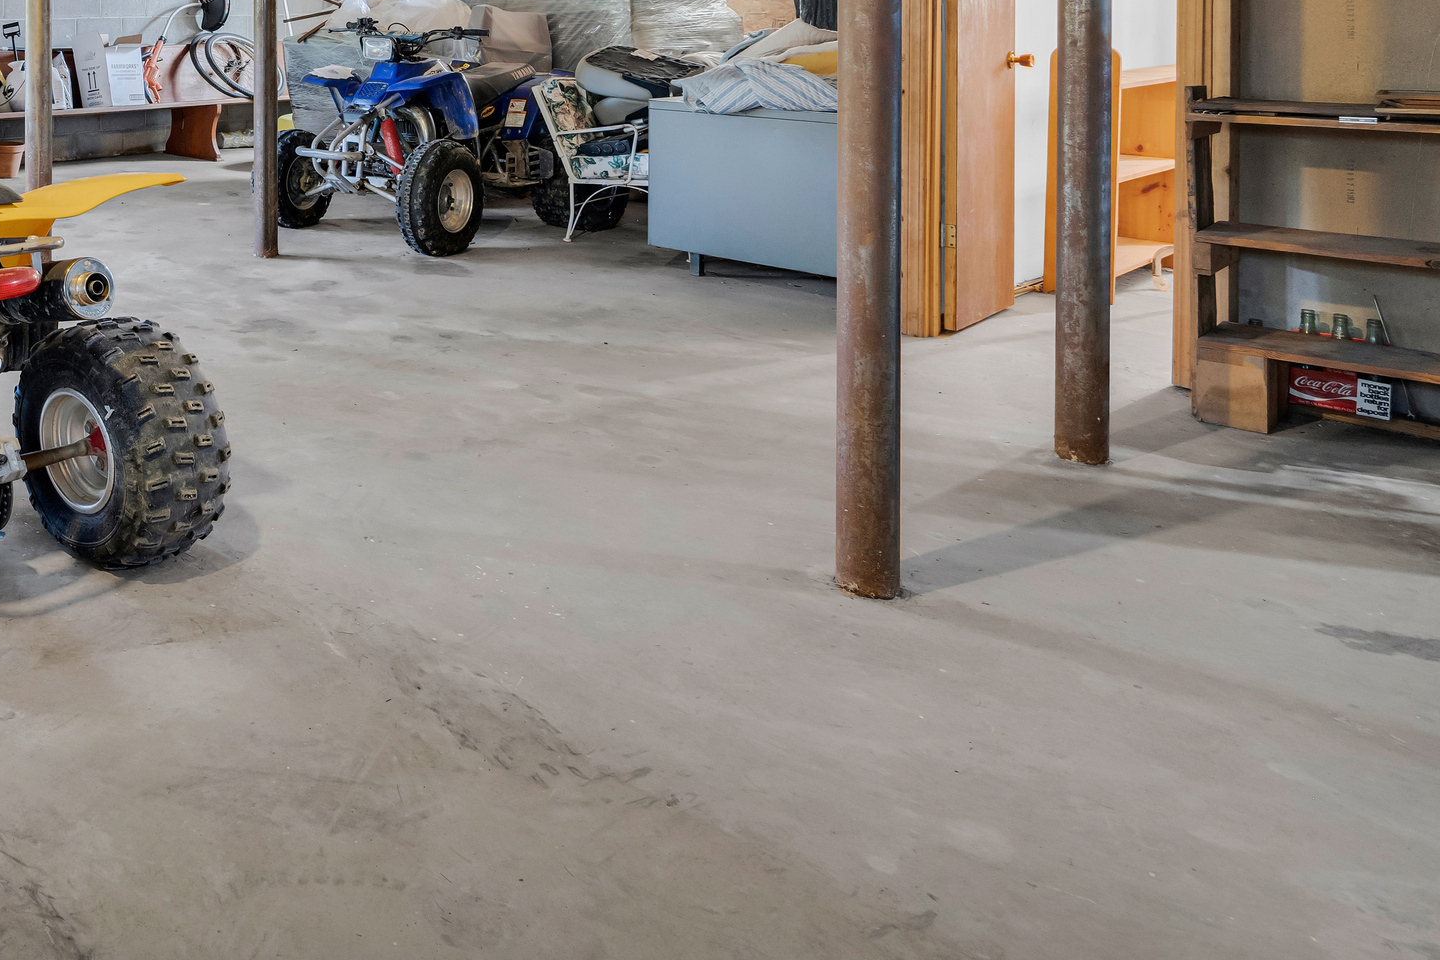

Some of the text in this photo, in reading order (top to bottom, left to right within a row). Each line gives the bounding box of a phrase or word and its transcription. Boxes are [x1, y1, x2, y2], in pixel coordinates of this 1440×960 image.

[1294, 375, 1354, 396] Coca-Cola
[1361, 382, 1390, 391] money
[1360, 392, 1390, 402] bottles
[1368, 388, 1390, 397] back
[1364, 399, 1389, 407] return
[1357, 407, 1389, 417] deposit
